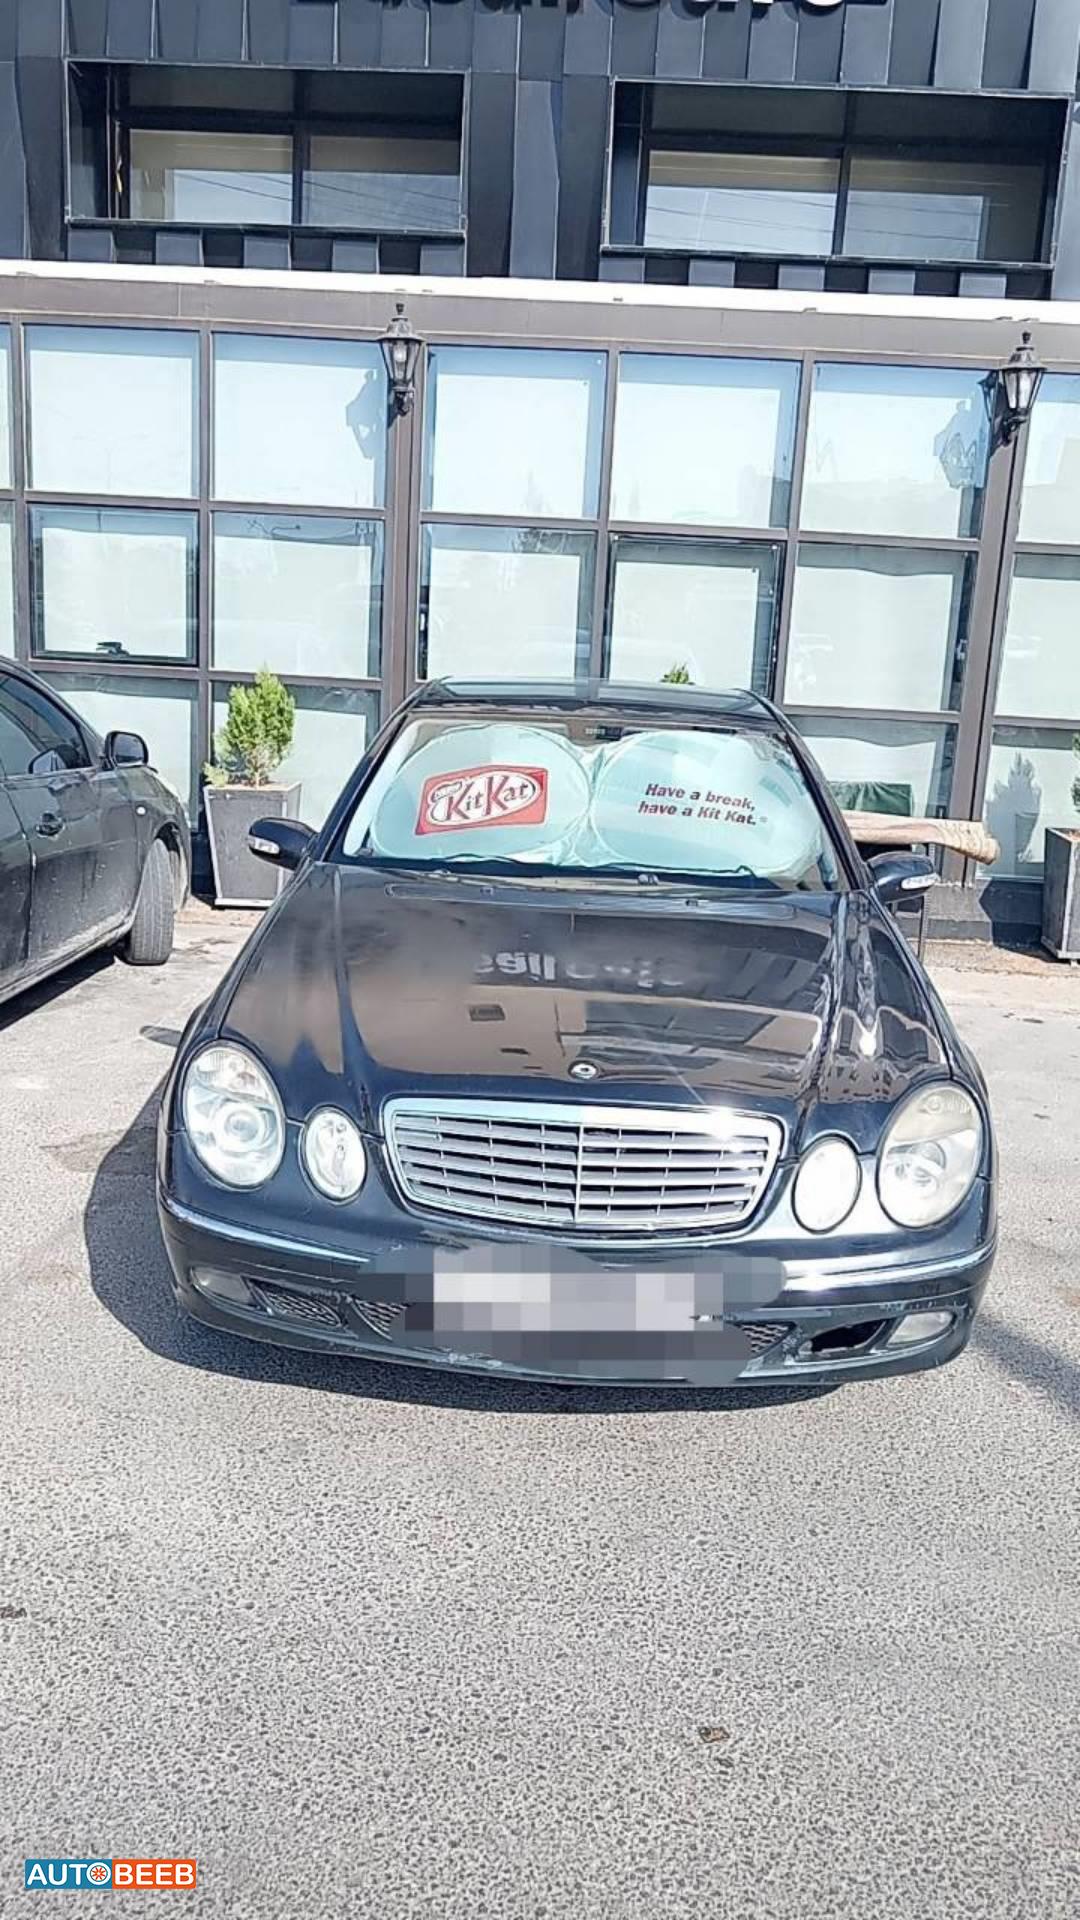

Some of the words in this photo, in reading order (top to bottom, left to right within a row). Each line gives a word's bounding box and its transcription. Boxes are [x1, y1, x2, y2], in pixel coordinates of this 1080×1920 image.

[645, 783, 686, 799] Have
[689, 790, 701, 801] a
[704, 790, 756, 812] break,
[638, 800, 678, 816] have
[681, 806, 693, 817] a
[697, 806, 721, 820] Kit
